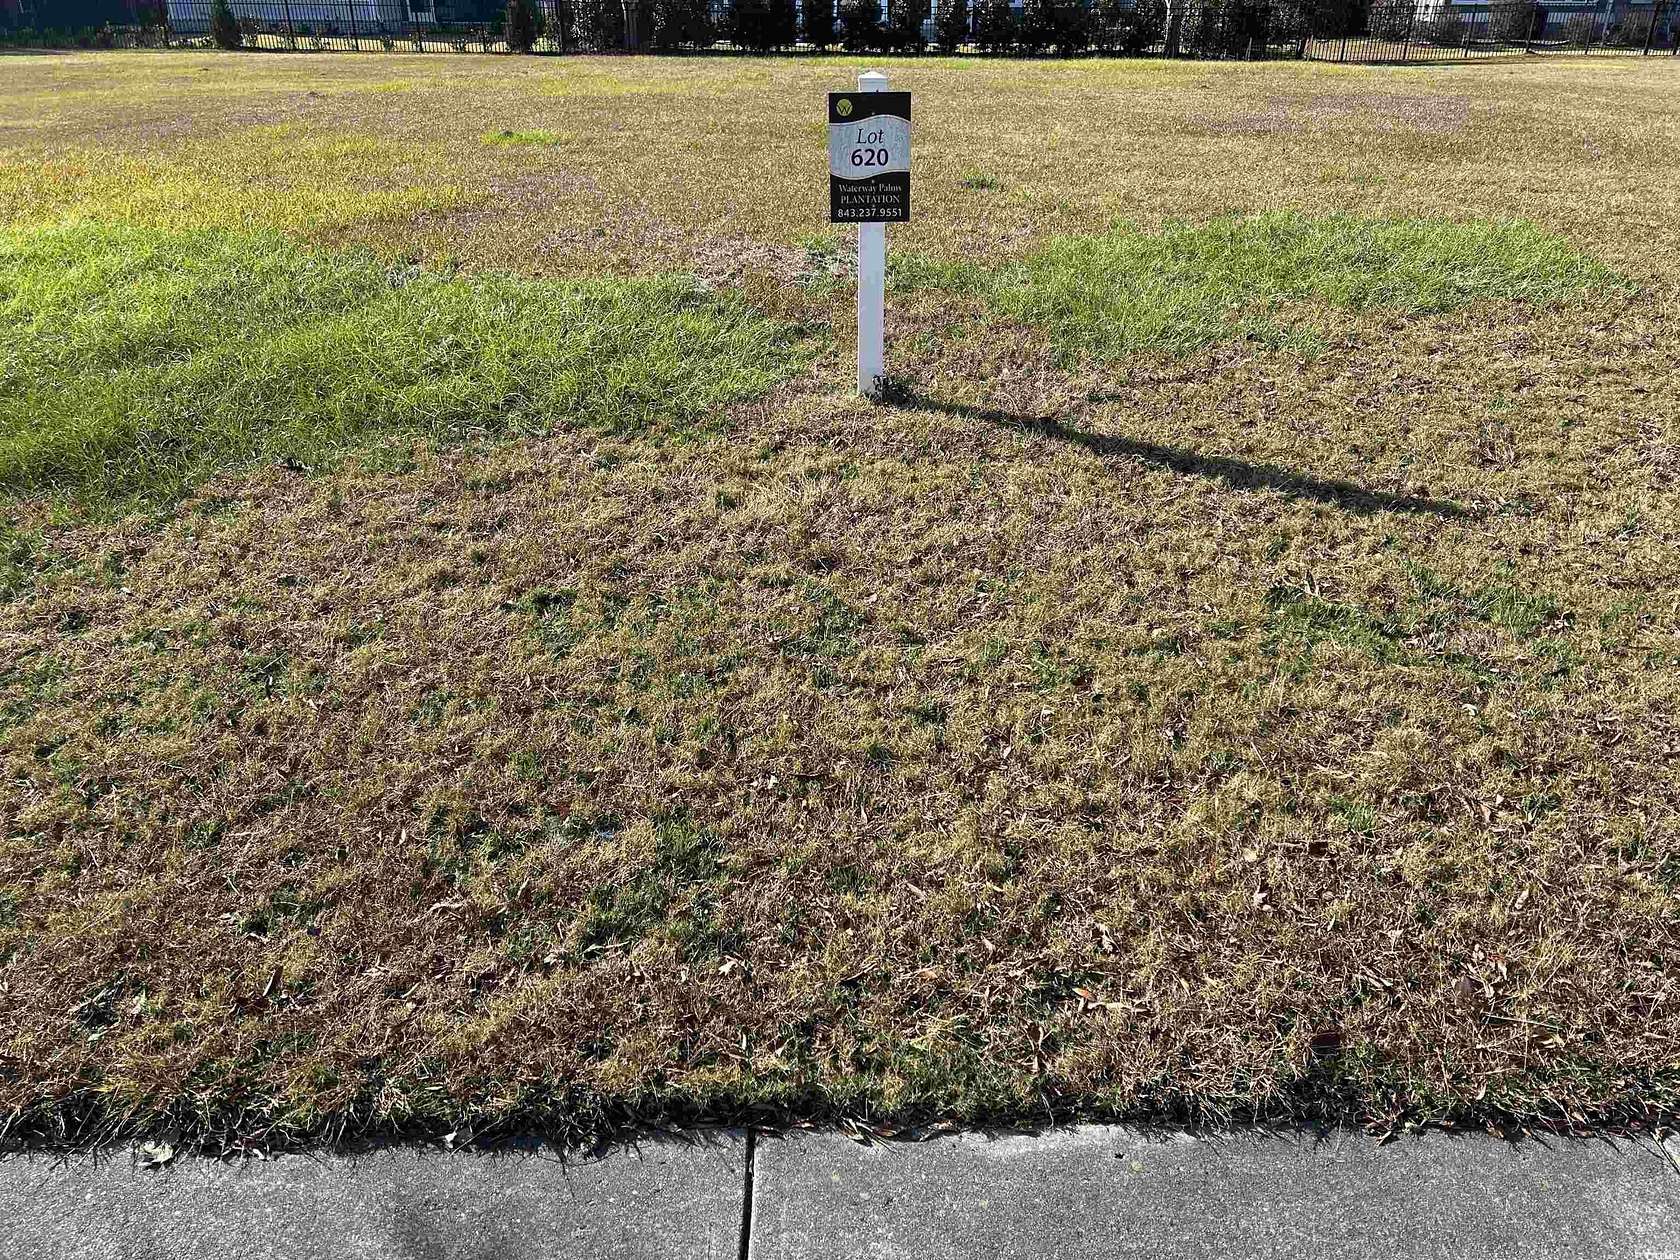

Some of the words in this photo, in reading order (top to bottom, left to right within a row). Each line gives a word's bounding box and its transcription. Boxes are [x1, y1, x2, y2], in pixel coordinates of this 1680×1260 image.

[857, 128, 885, 144] Lot
[851, 148, 889, 166] 620
[838, 184, 876, 193] Waterway
[879, 183, 902, 192] Palms
[840, 194, 900, 204] PLANTATION
[837, 208, 902, 218] 843.237.9551
